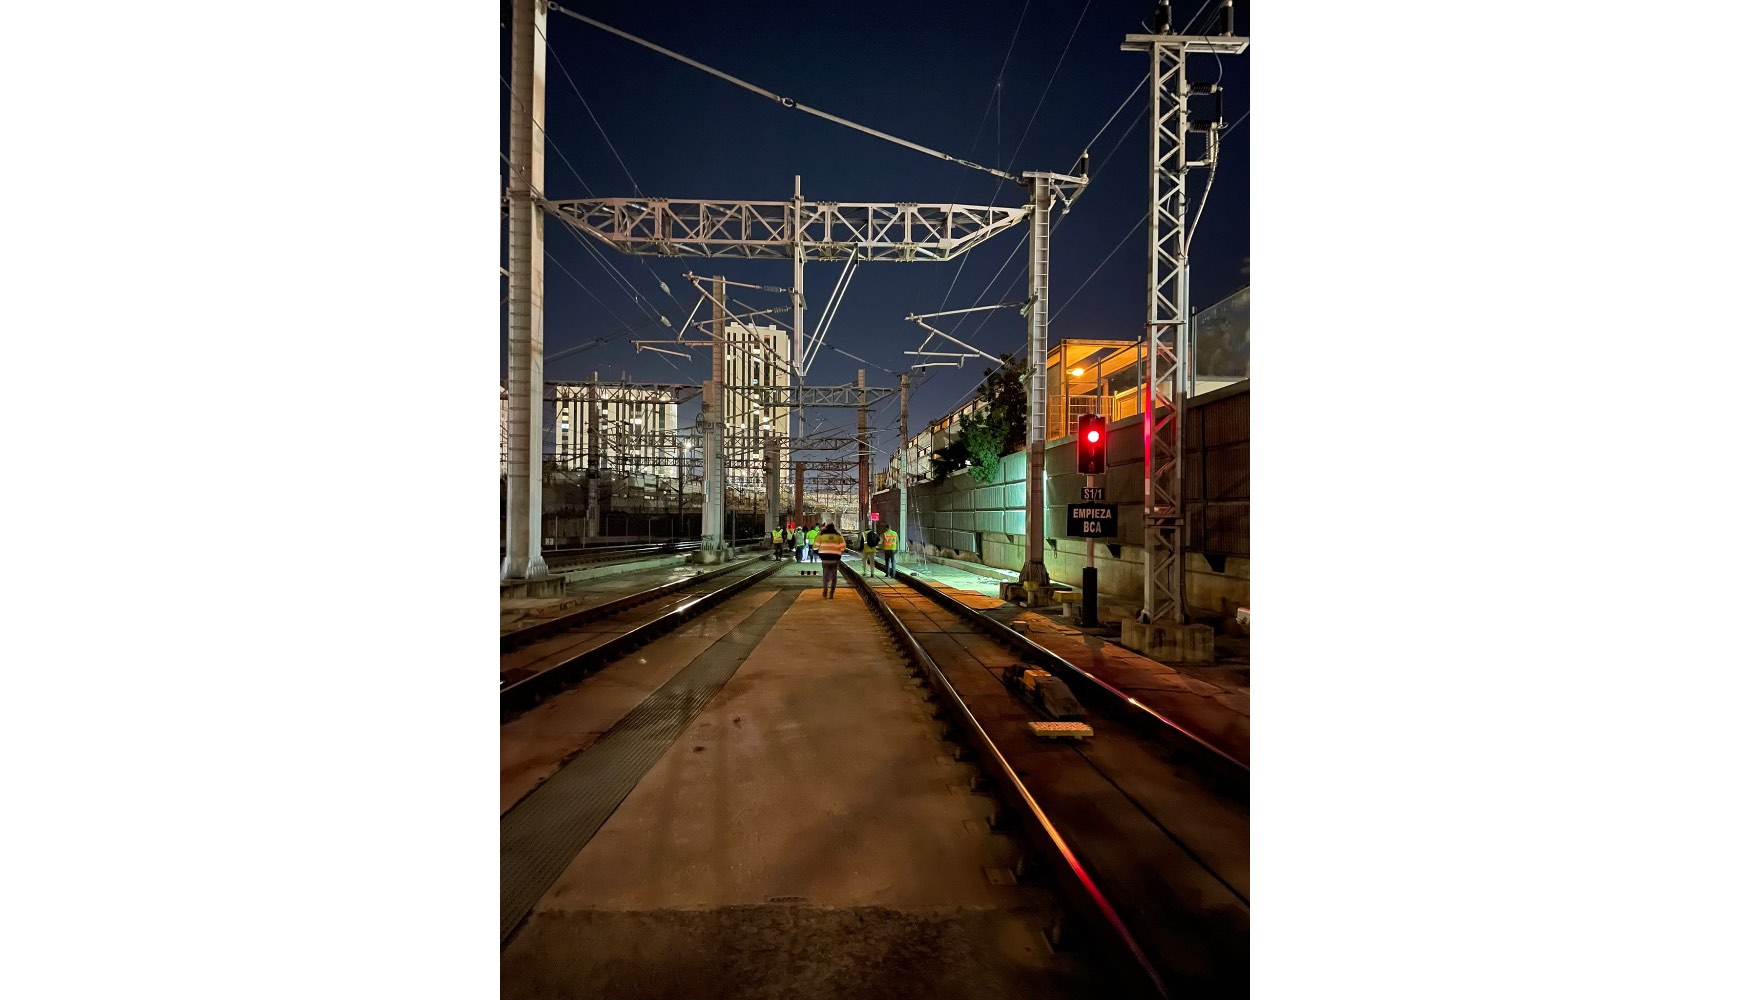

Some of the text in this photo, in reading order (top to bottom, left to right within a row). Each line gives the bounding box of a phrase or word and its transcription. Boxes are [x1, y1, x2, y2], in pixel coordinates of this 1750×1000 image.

[1084, 489, 1102, 500] S1/1
[1073, 508, 1112, 519] EMPIEZA
[1083, 521, 1102, 533] BCA
